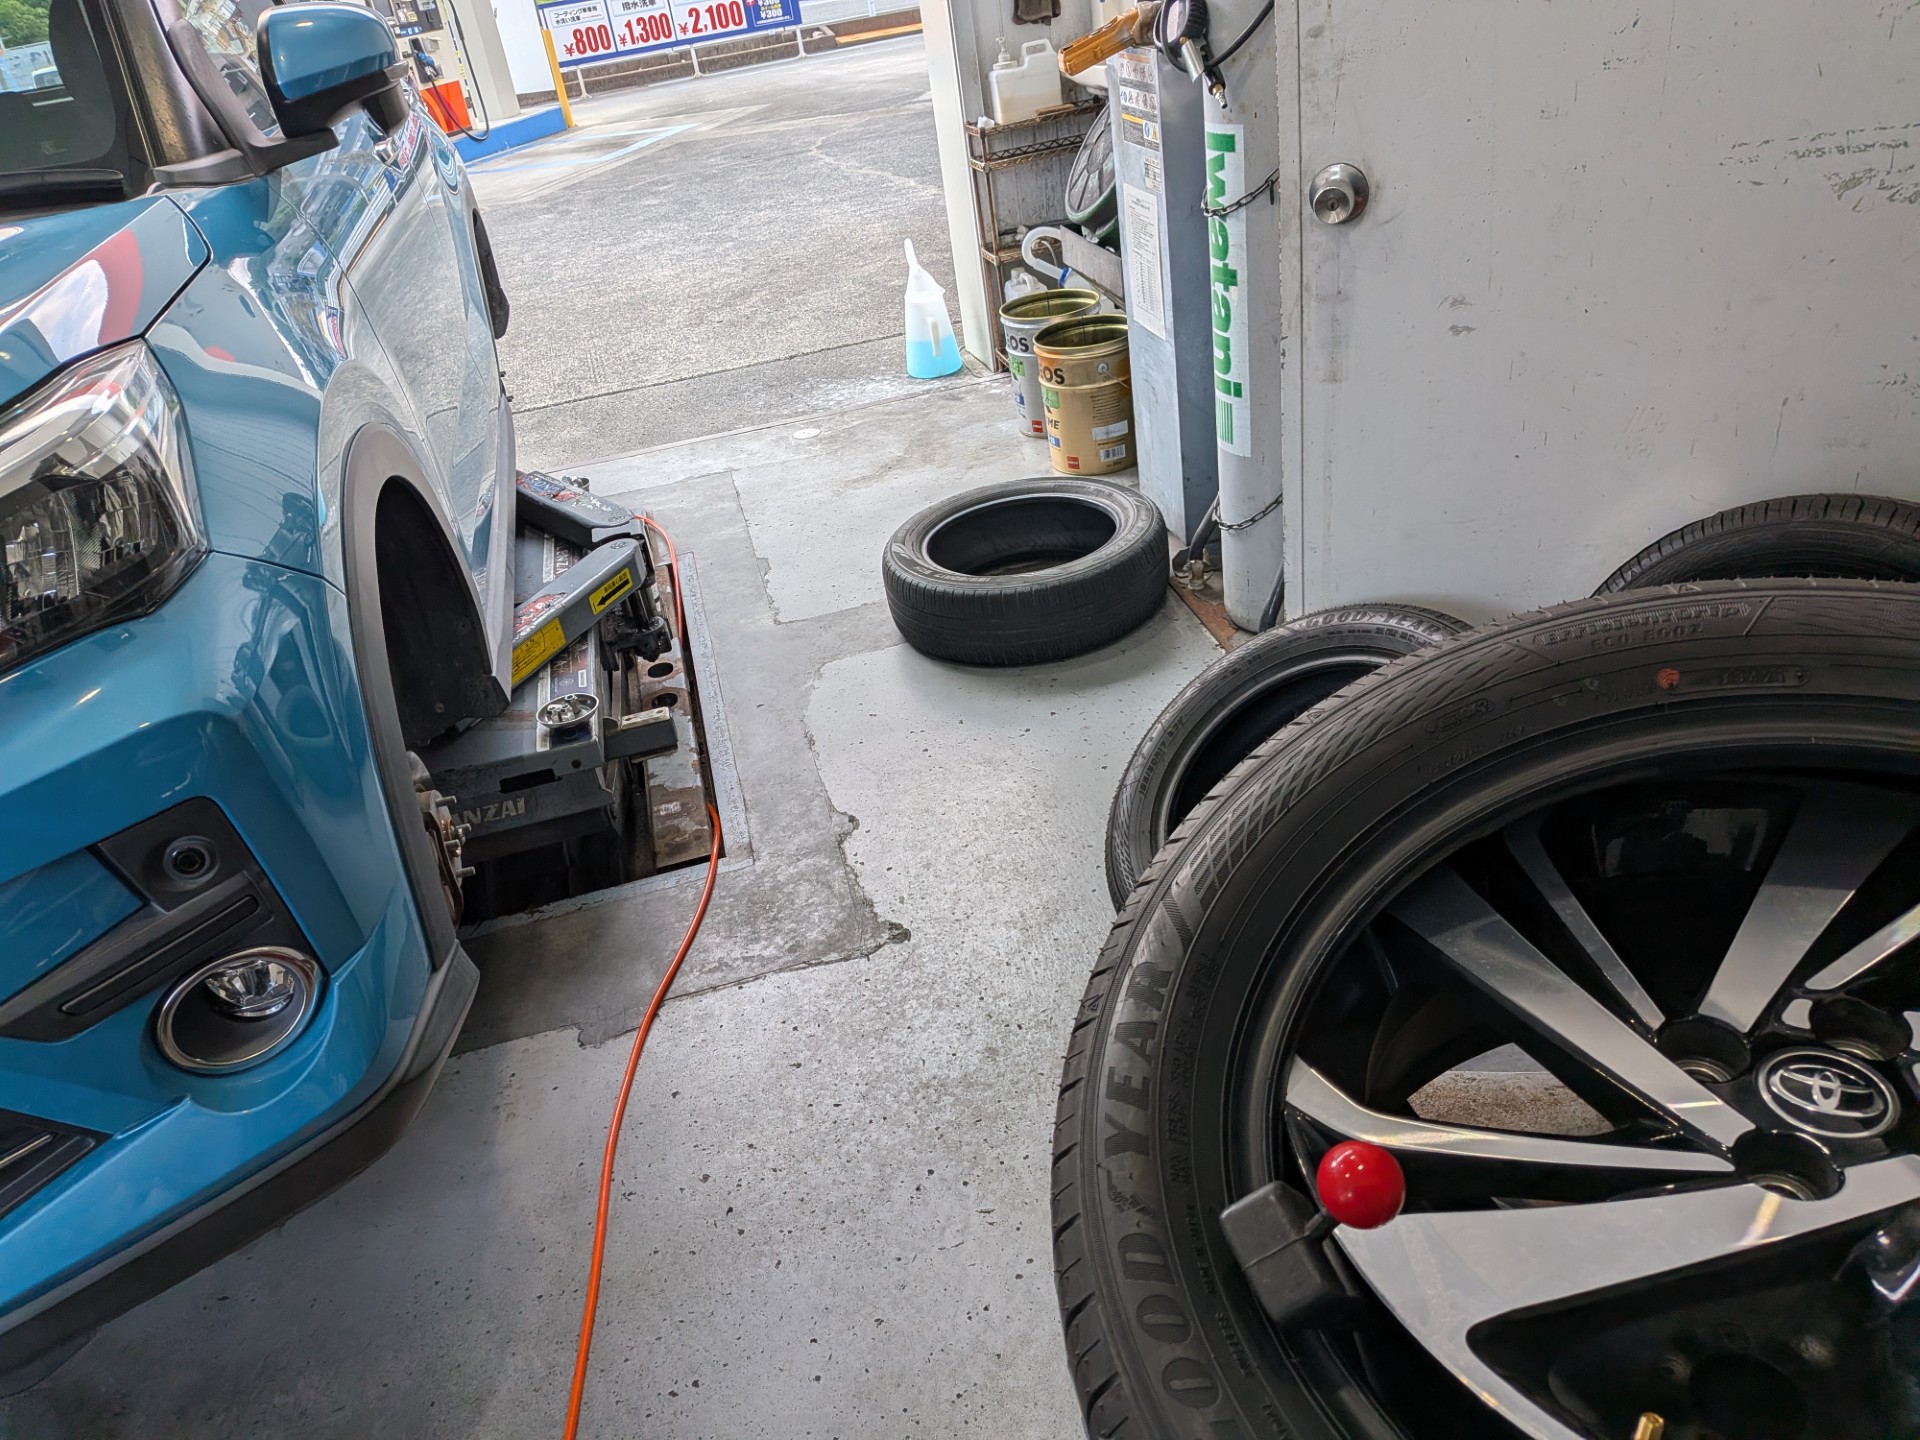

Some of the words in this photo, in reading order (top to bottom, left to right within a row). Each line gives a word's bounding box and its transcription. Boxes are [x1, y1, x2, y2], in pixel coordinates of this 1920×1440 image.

[617, 12, 673, 47] ¥1,300
[678, 1, 744, 36] ¥2,100
[760, 8, 783, 19] ¥300
[563, 24, 612, 57] ¥800
[1205, 131, 1243, 399] Iwatani
[451, 796, 526, 826] ANZAI
